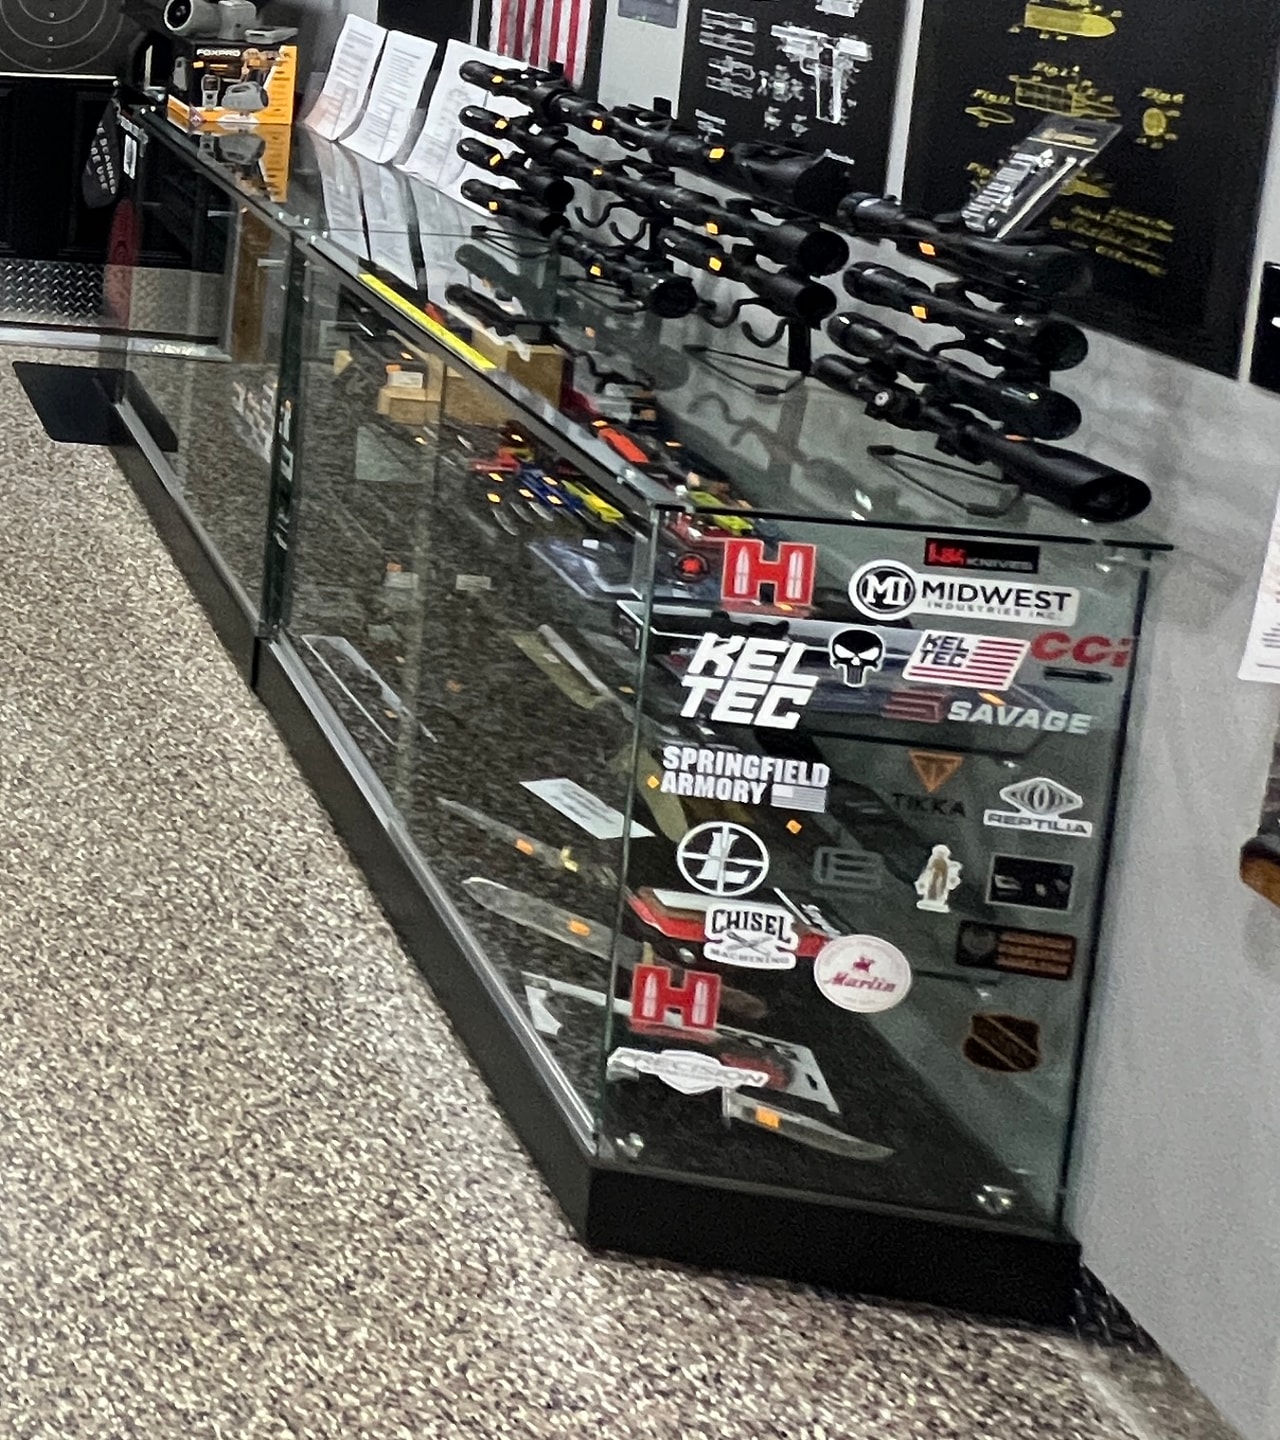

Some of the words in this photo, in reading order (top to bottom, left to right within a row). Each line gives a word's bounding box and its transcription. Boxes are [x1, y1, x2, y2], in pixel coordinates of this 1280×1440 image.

[196, 48, 240, 57] FOXPRO
[723, 540, 816, 606] H
[966, 559, 1033, 571] KNIVES
[922, 580, 1072, 611] MIDWEST
[928, 601, 1021, 617] INDUSTRIES
[920, 649, 966, 667] TEC
[923, 634, 969, 652] KEL
[686, 633, 818, 686] KEL
[680, 675, 811, 729] TEC
[948, 701, 1092, 735] SAVAGE
[662, 746, 830, 788] SPRINGFIELD
[661, 772, 766, 805] ARMORY
[893, 792, 967, 818] TIKKA
[988, 814, 1088, 835] REPTILIA
[711, 909, 792, 944] CHISEL
[631, 964, 720, 1031] H
[823, 972, 896, 993] Marlin
